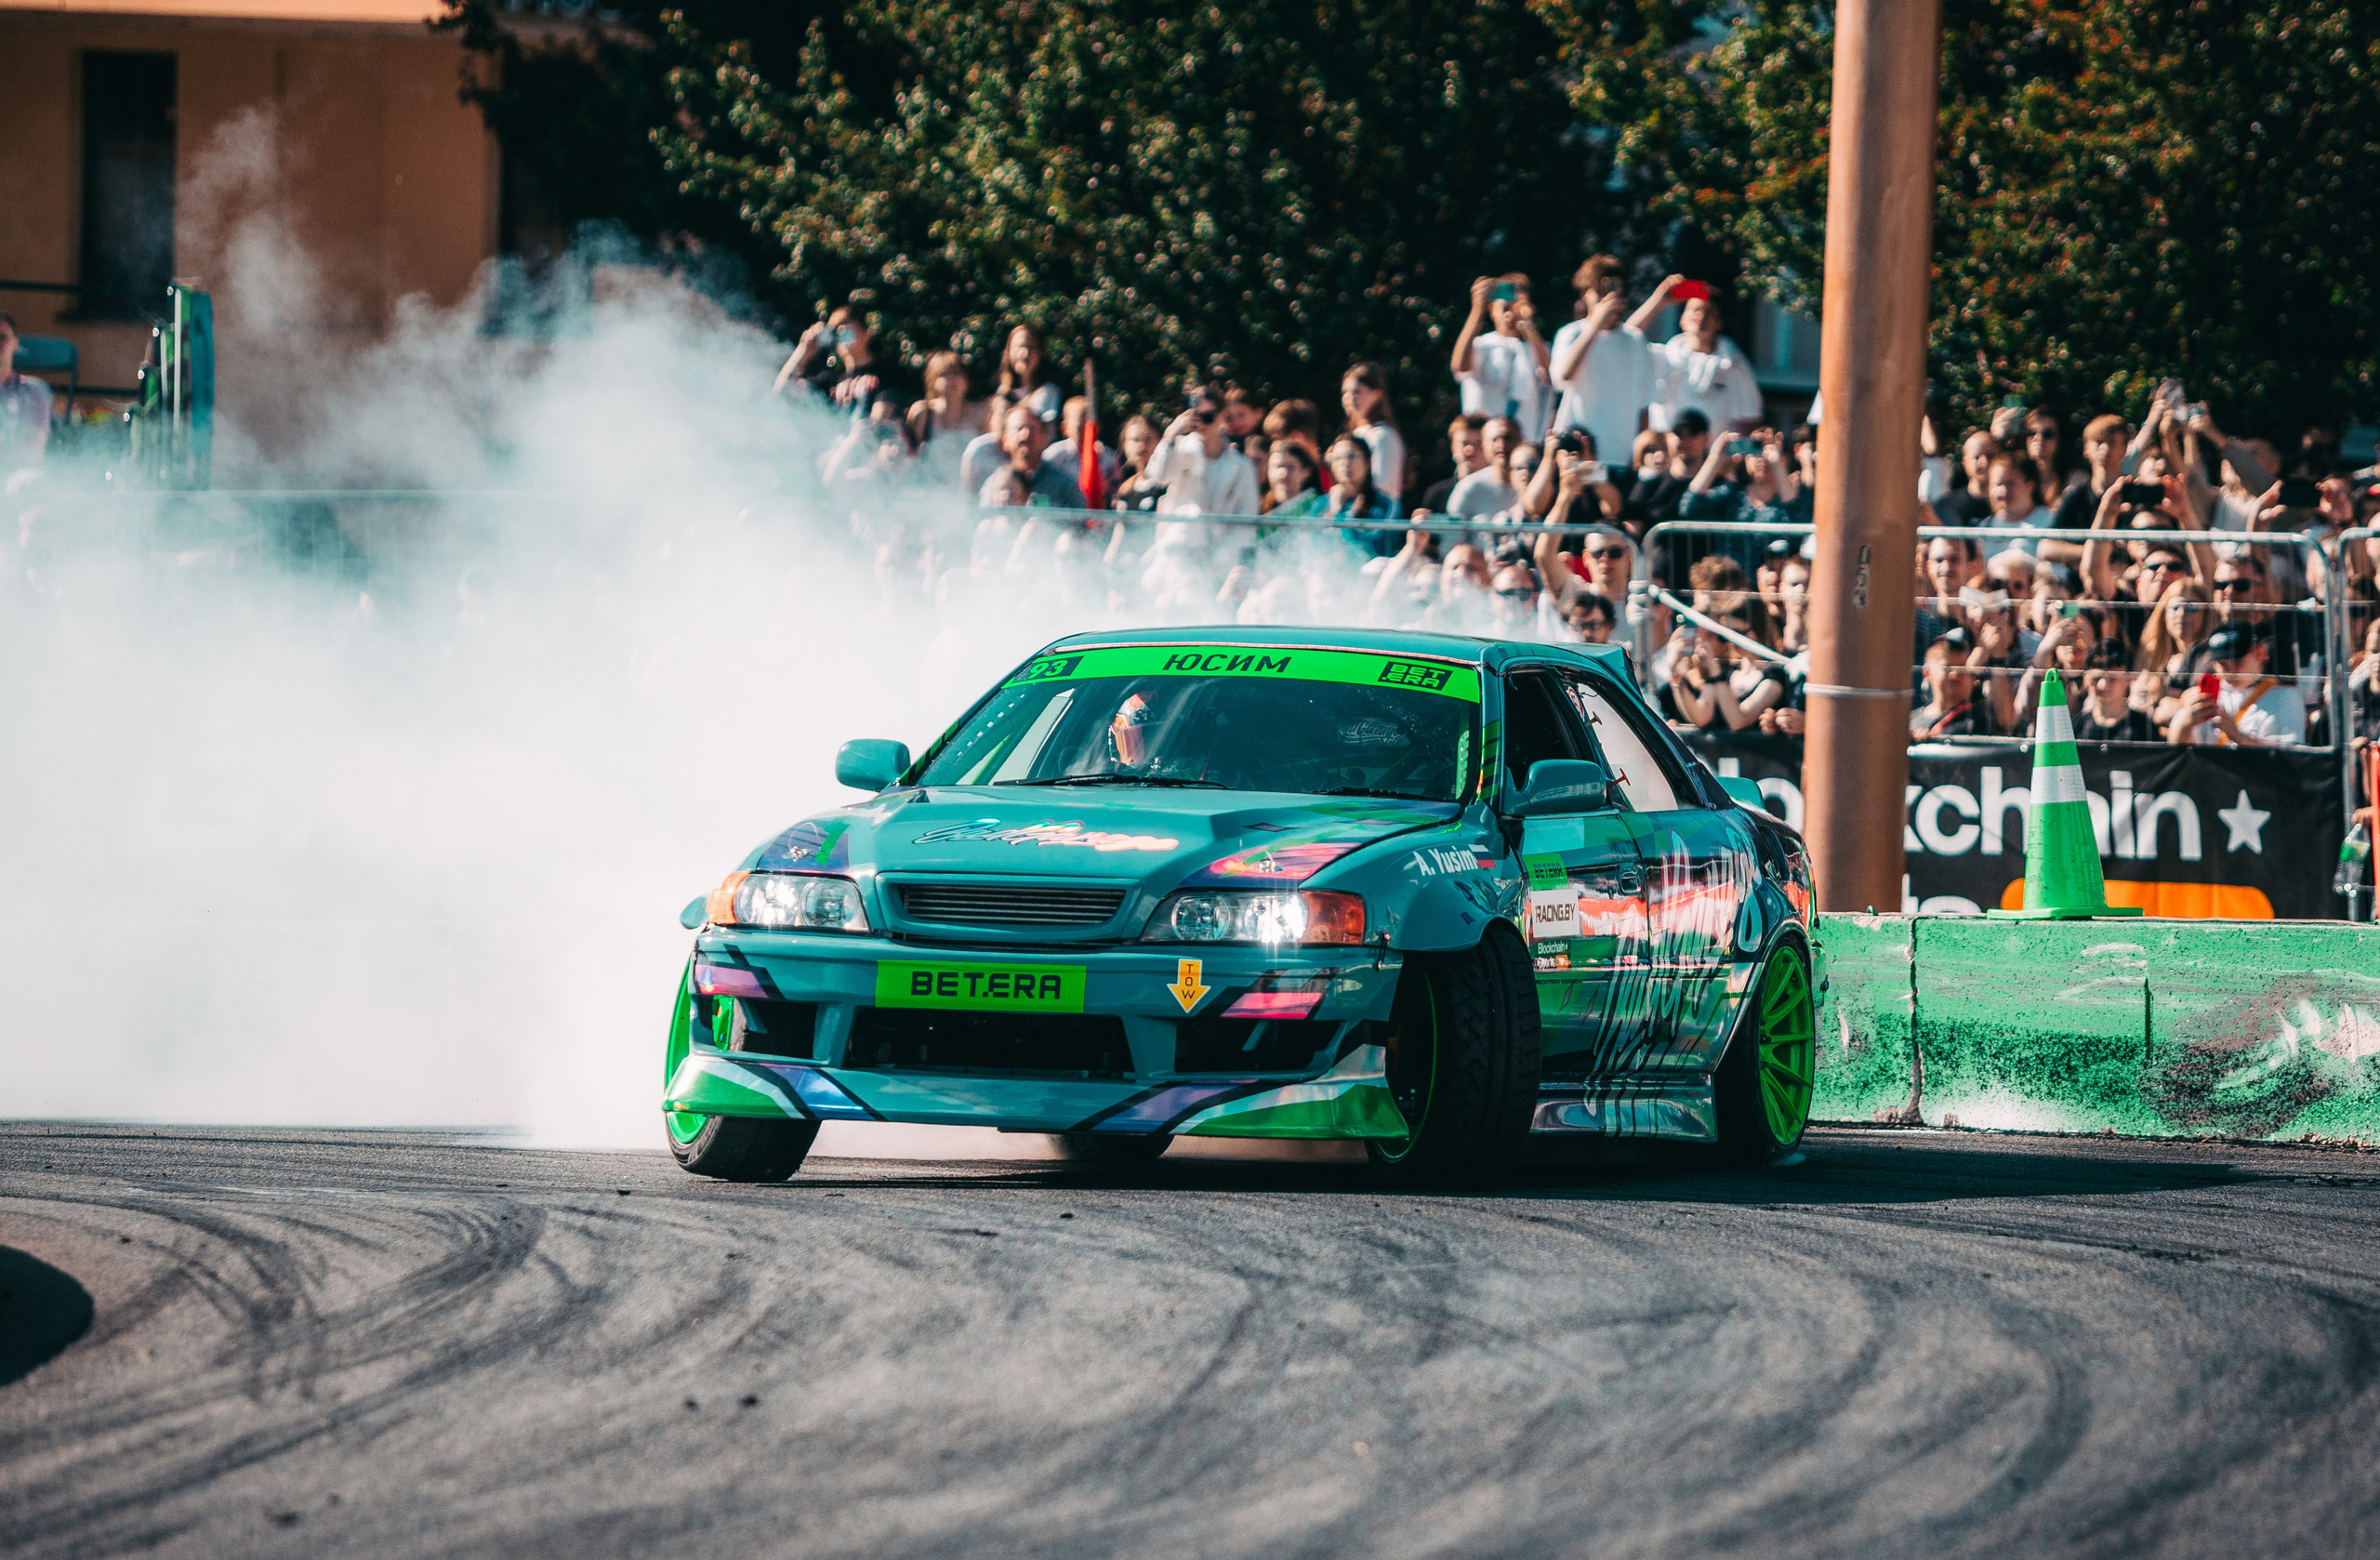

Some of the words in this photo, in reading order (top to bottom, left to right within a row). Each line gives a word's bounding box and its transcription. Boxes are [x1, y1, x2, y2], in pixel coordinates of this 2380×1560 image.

[1027, 659, 1068, 680] 93
[1162, 654, 1292, 673] ЮСИМ
[1390, 664, 1446, 679] BET
[1413, 851, 1436, 876] A.
[1428, 845, 1479, 874] Yusim
[1538, 941, 1566, 955] Blockchain
[1181, 963, 1196, 999] TOW
